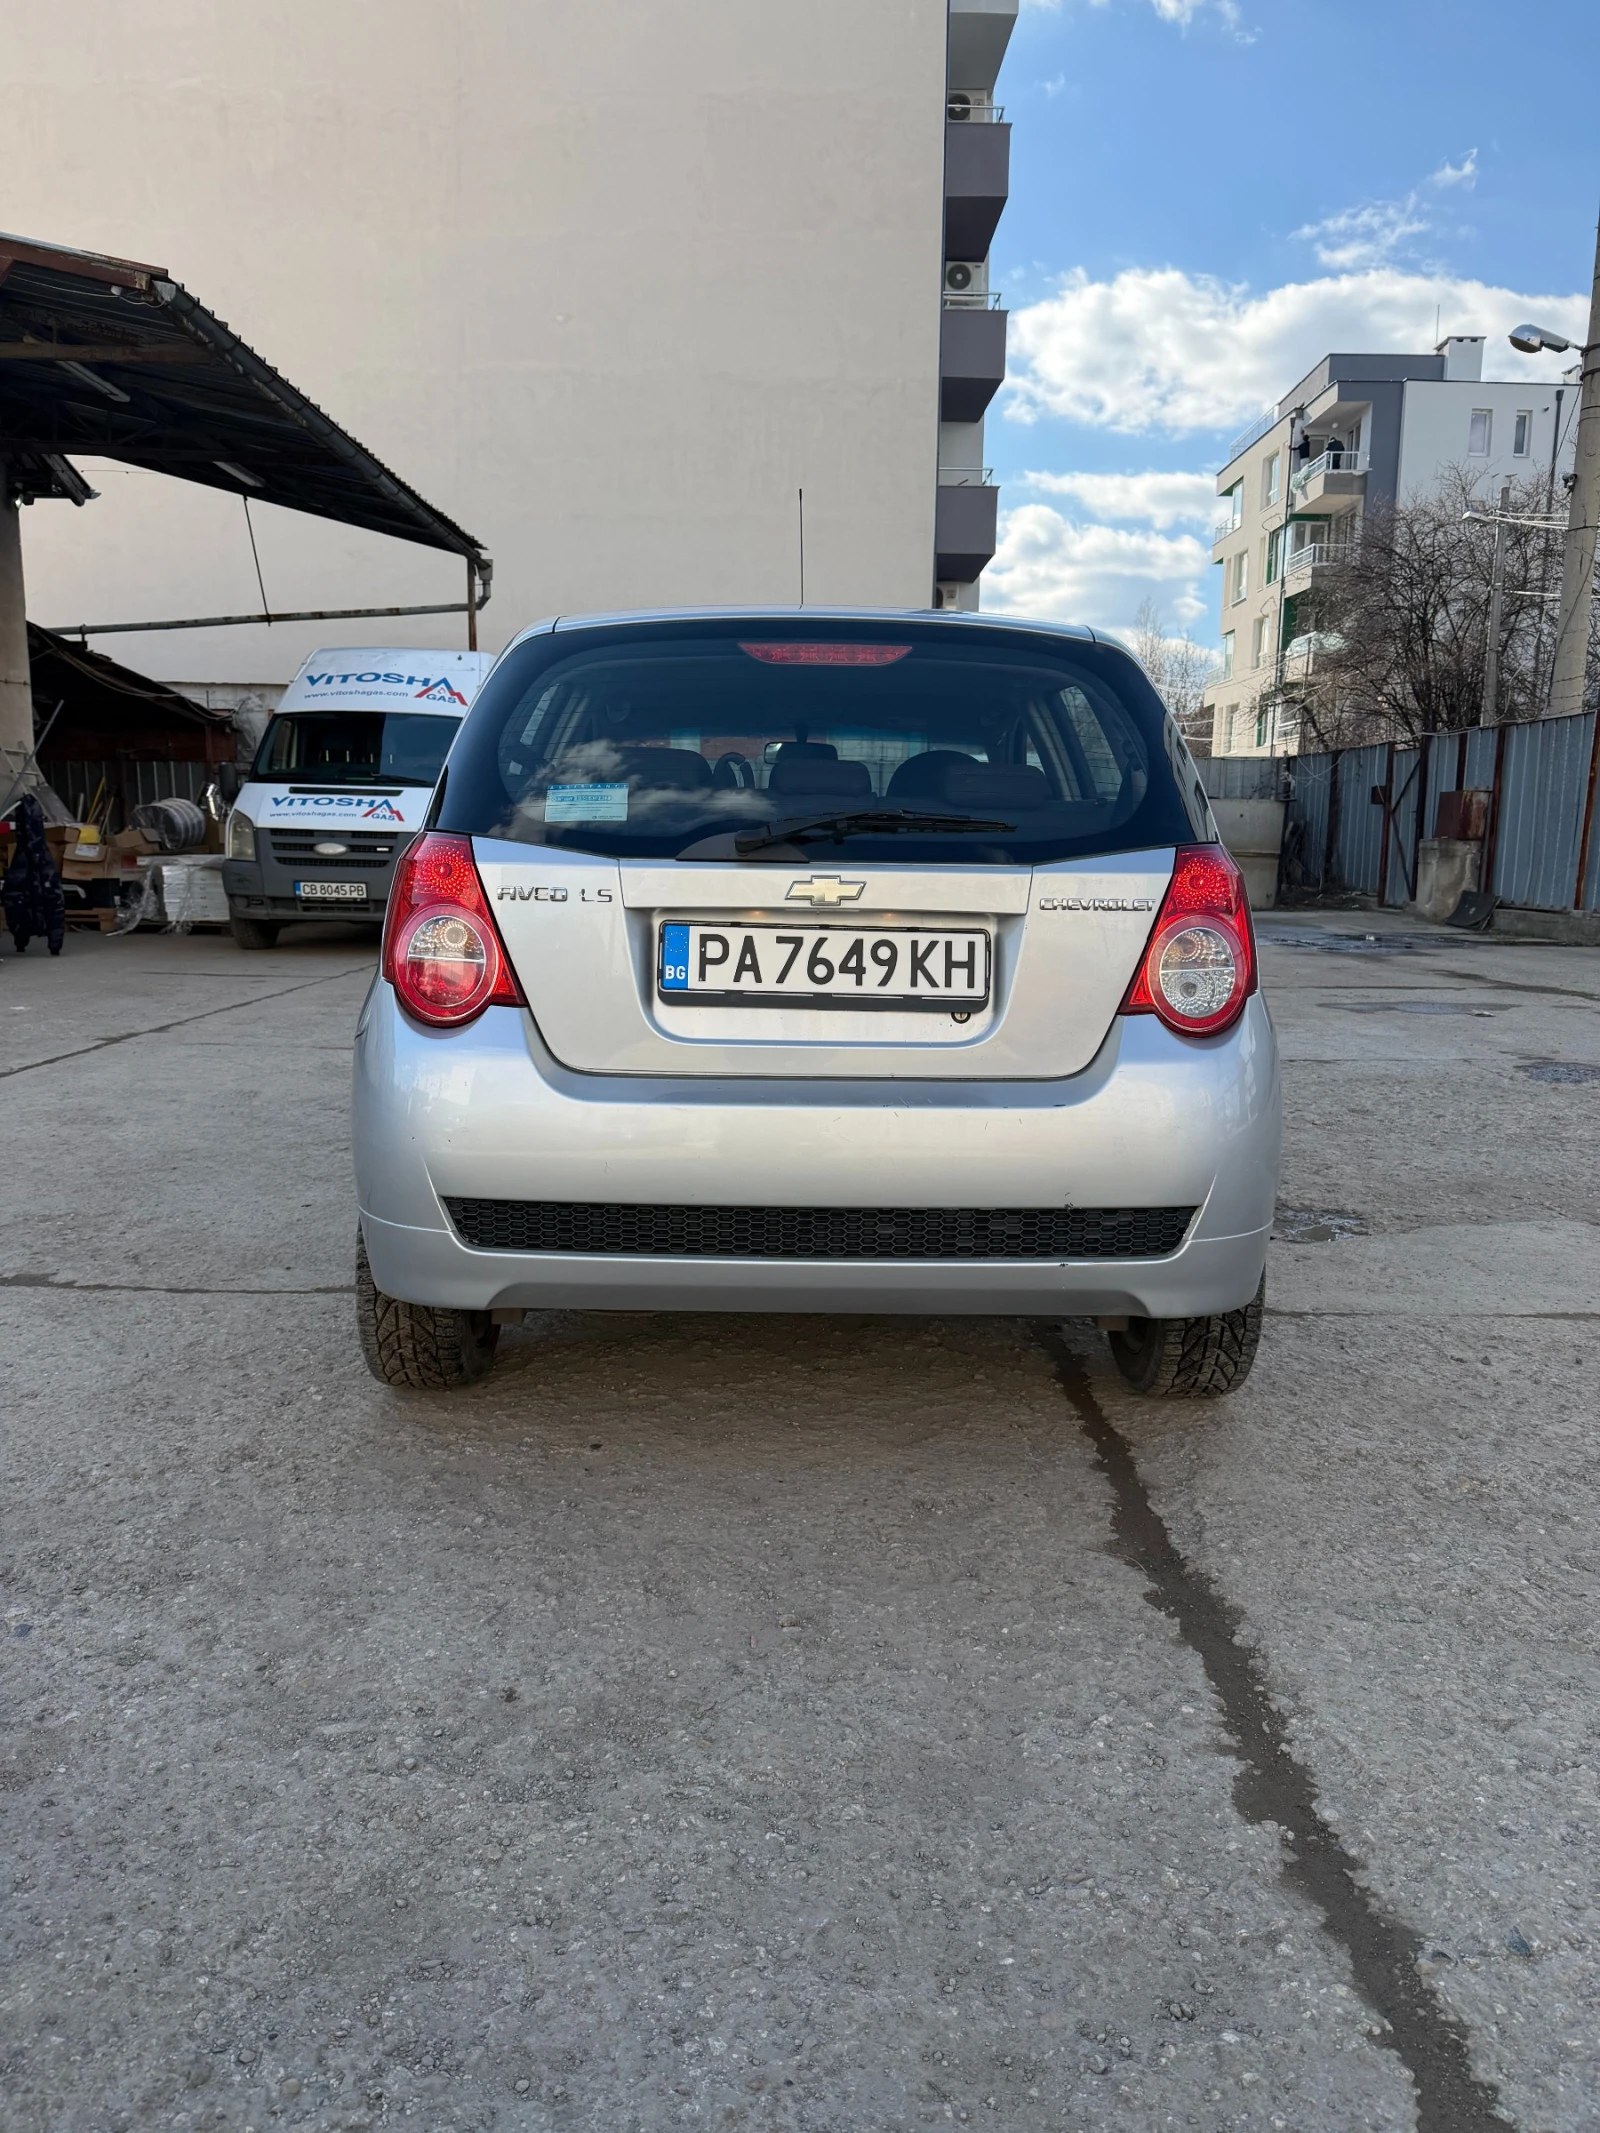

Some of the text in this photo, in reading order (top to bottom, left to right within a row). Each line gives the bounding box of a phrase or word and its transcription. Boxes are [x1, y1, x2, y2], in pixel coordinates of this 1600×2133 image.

[303, 689, 409, 699] www.vitoshagas.com
[306, 672, 465, 703] VITOSHA
[425, 693, 458, 704] GAS
[269, 810, 357, 818] www.vitoshagas.com
[271, 796, 403, 820] VITOSHA
[371, 812, 396, 822] GAS
[301, 883, 366, 897] CB 8045 PB
[496, 885, 613, 903] AVEO LS
[1039, 897, 1157, 912] CHEVROLET
[698, 933, 976, 989] PA 7649 KH
[664, 965, 687, 980] BG
